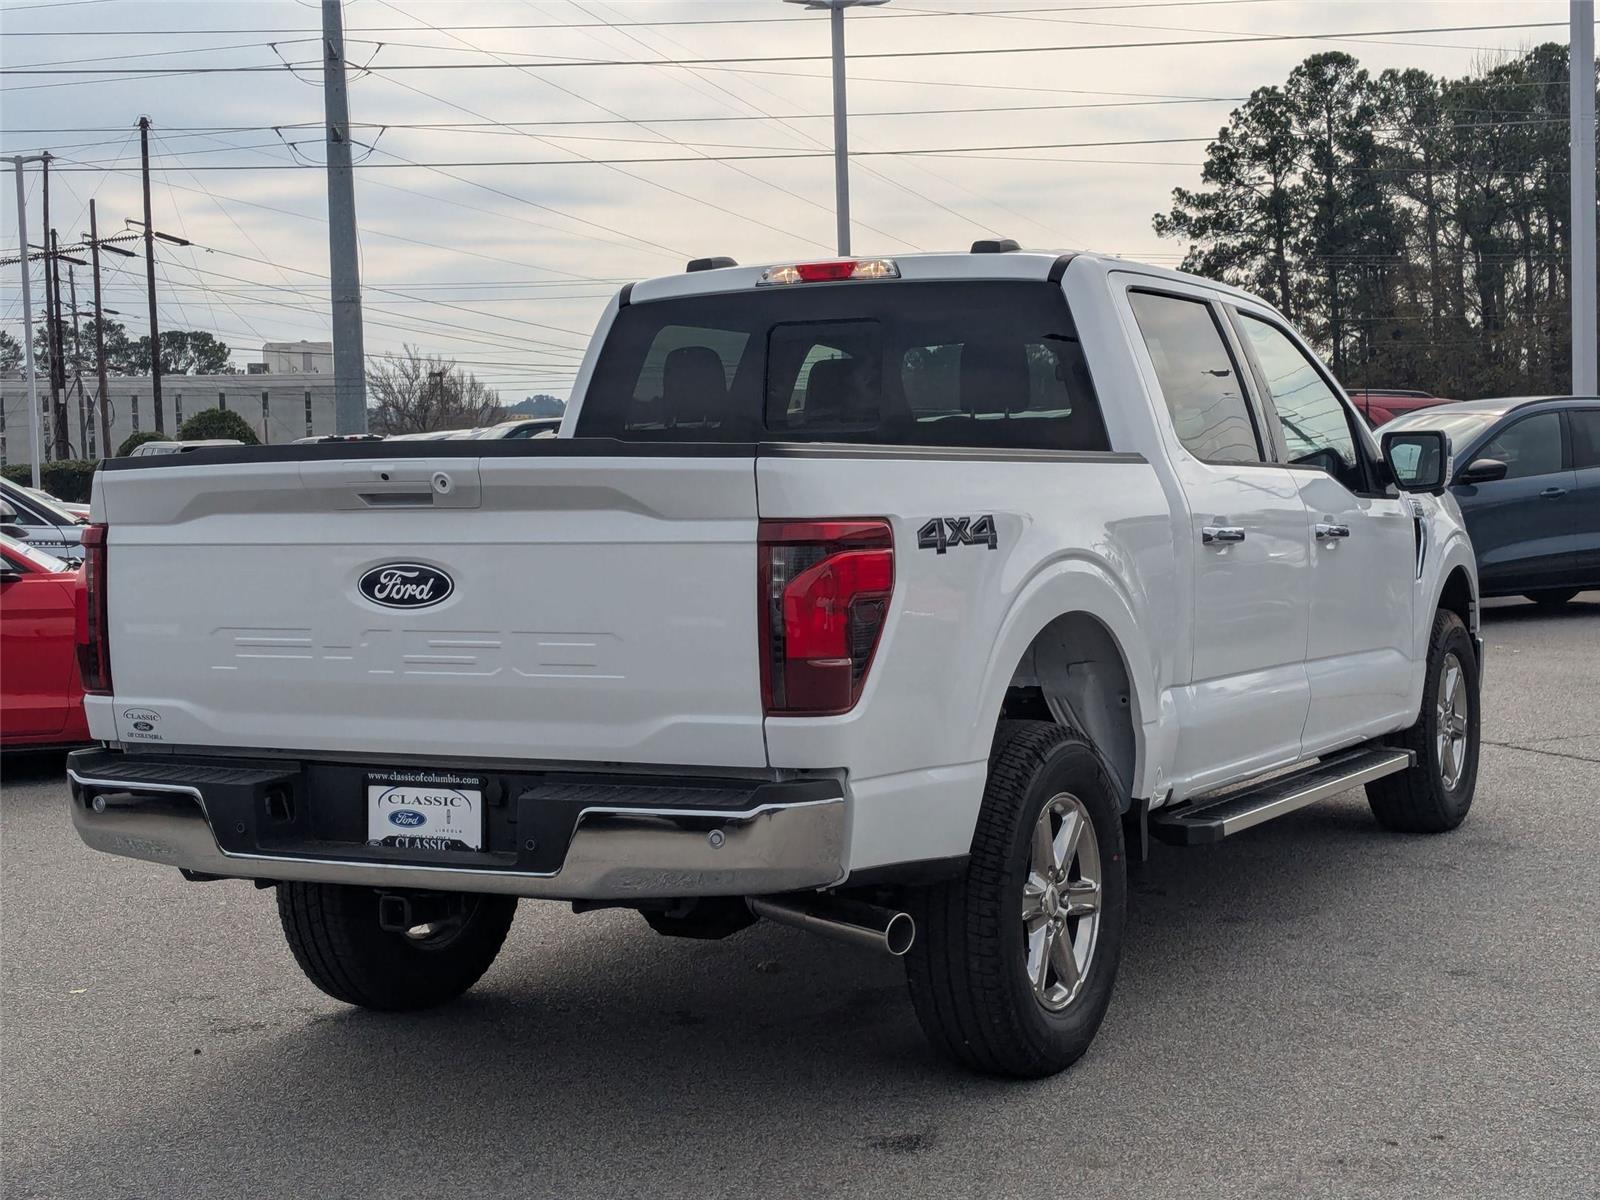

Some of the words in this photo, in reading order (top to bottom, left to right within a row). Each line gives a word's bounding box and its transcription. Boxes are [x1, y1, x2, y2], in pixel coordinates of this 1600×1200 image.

[374, 569, 435, 600] Ford
[126, 712, 160, 721] CLASSIC
[367, 771, 479, 784] www.classicofcolumbia.com
[387, 794, 462, 808] CLASSIC
[395, 812, 420, 825] Ford
[395, 837, 452, 850] CLASSIC
